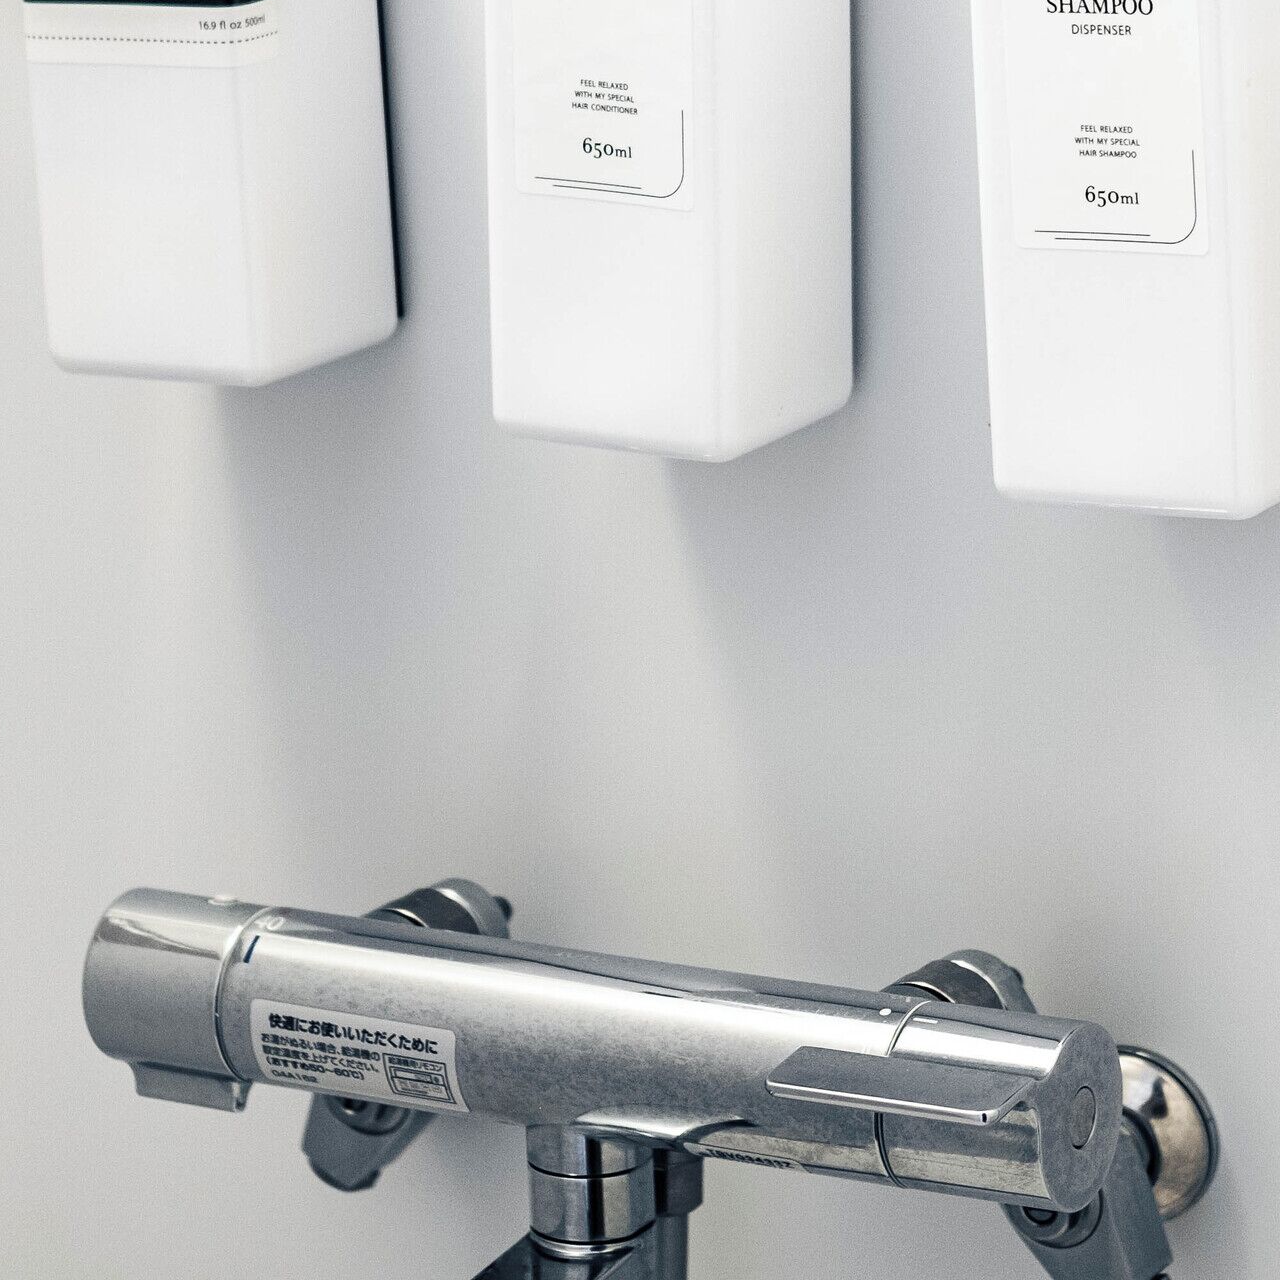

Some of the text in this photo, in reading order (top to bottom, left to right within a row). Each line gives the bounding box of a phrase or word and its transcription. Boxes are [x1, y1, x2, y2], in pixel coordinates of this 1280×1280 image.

[199, 20, 217, 30] 16.9
[229, 21, 242, 29] oz
[1071, 24, 1132, 36] DISPENSER
[580, 79, 629, 91] FEEL RELAXED
[575, 91, 634, 103] WITH MY SPECIAL
[572, 102, 638, 115] HAIR CONDITIONER
[1080, 124, 1133, 134] FEEL RELAXED
[582, 137, 633, 159] 650ml
[1075, 137, 1140, 147] WITH MY SPECIAL
[1079, 149, 1137, 158] HAIR SHAMPOO
[1085, 185, 1139, 207] 650ml
[268, 1012, 438, 1055] 快適にお使いいただくために
